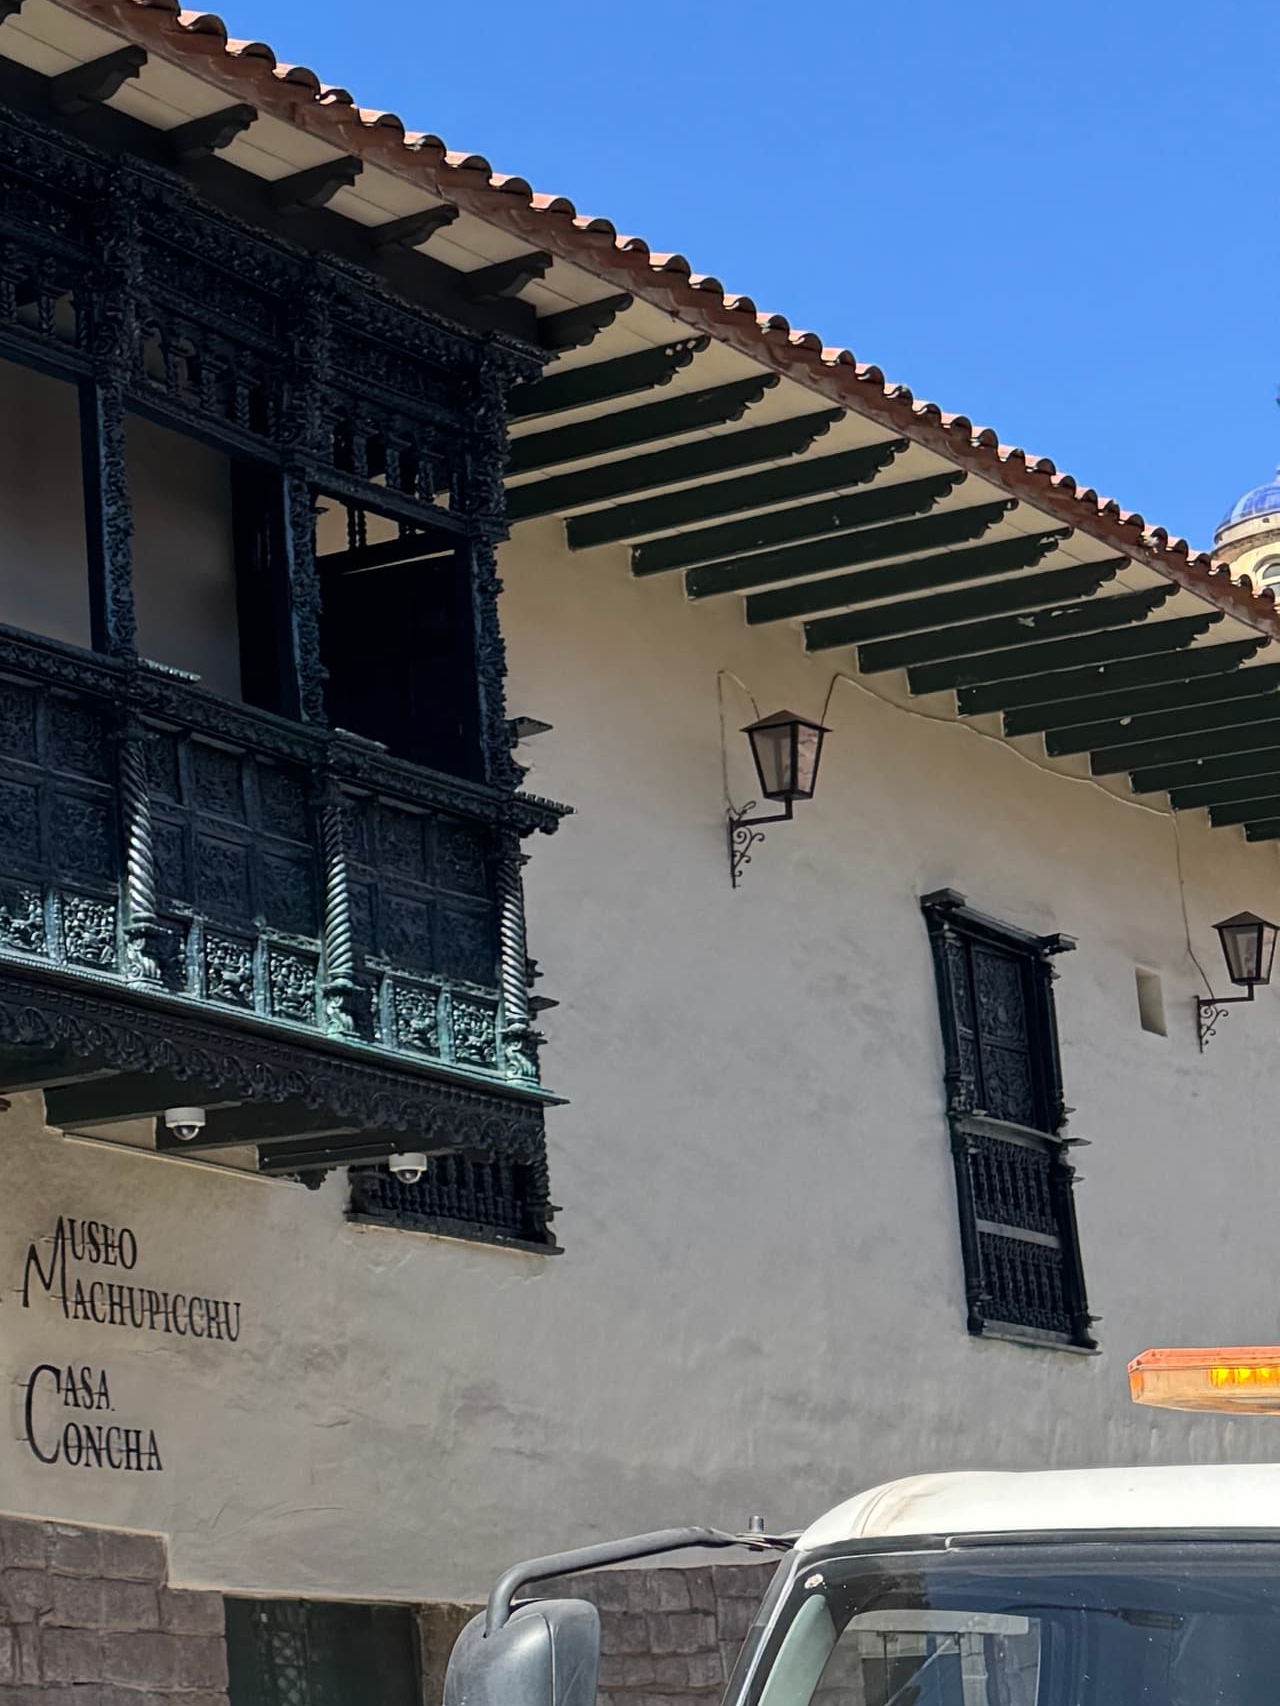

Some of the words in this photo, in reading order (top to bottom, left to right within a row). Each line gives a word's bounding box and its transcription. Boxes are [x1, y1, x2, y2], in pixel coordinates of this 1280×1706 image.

[22, 1215, 138, 1319] MUSEO
[24, 1363, 111, 1465] CASA
[24, 1363, 163, 1471] CONCHA
